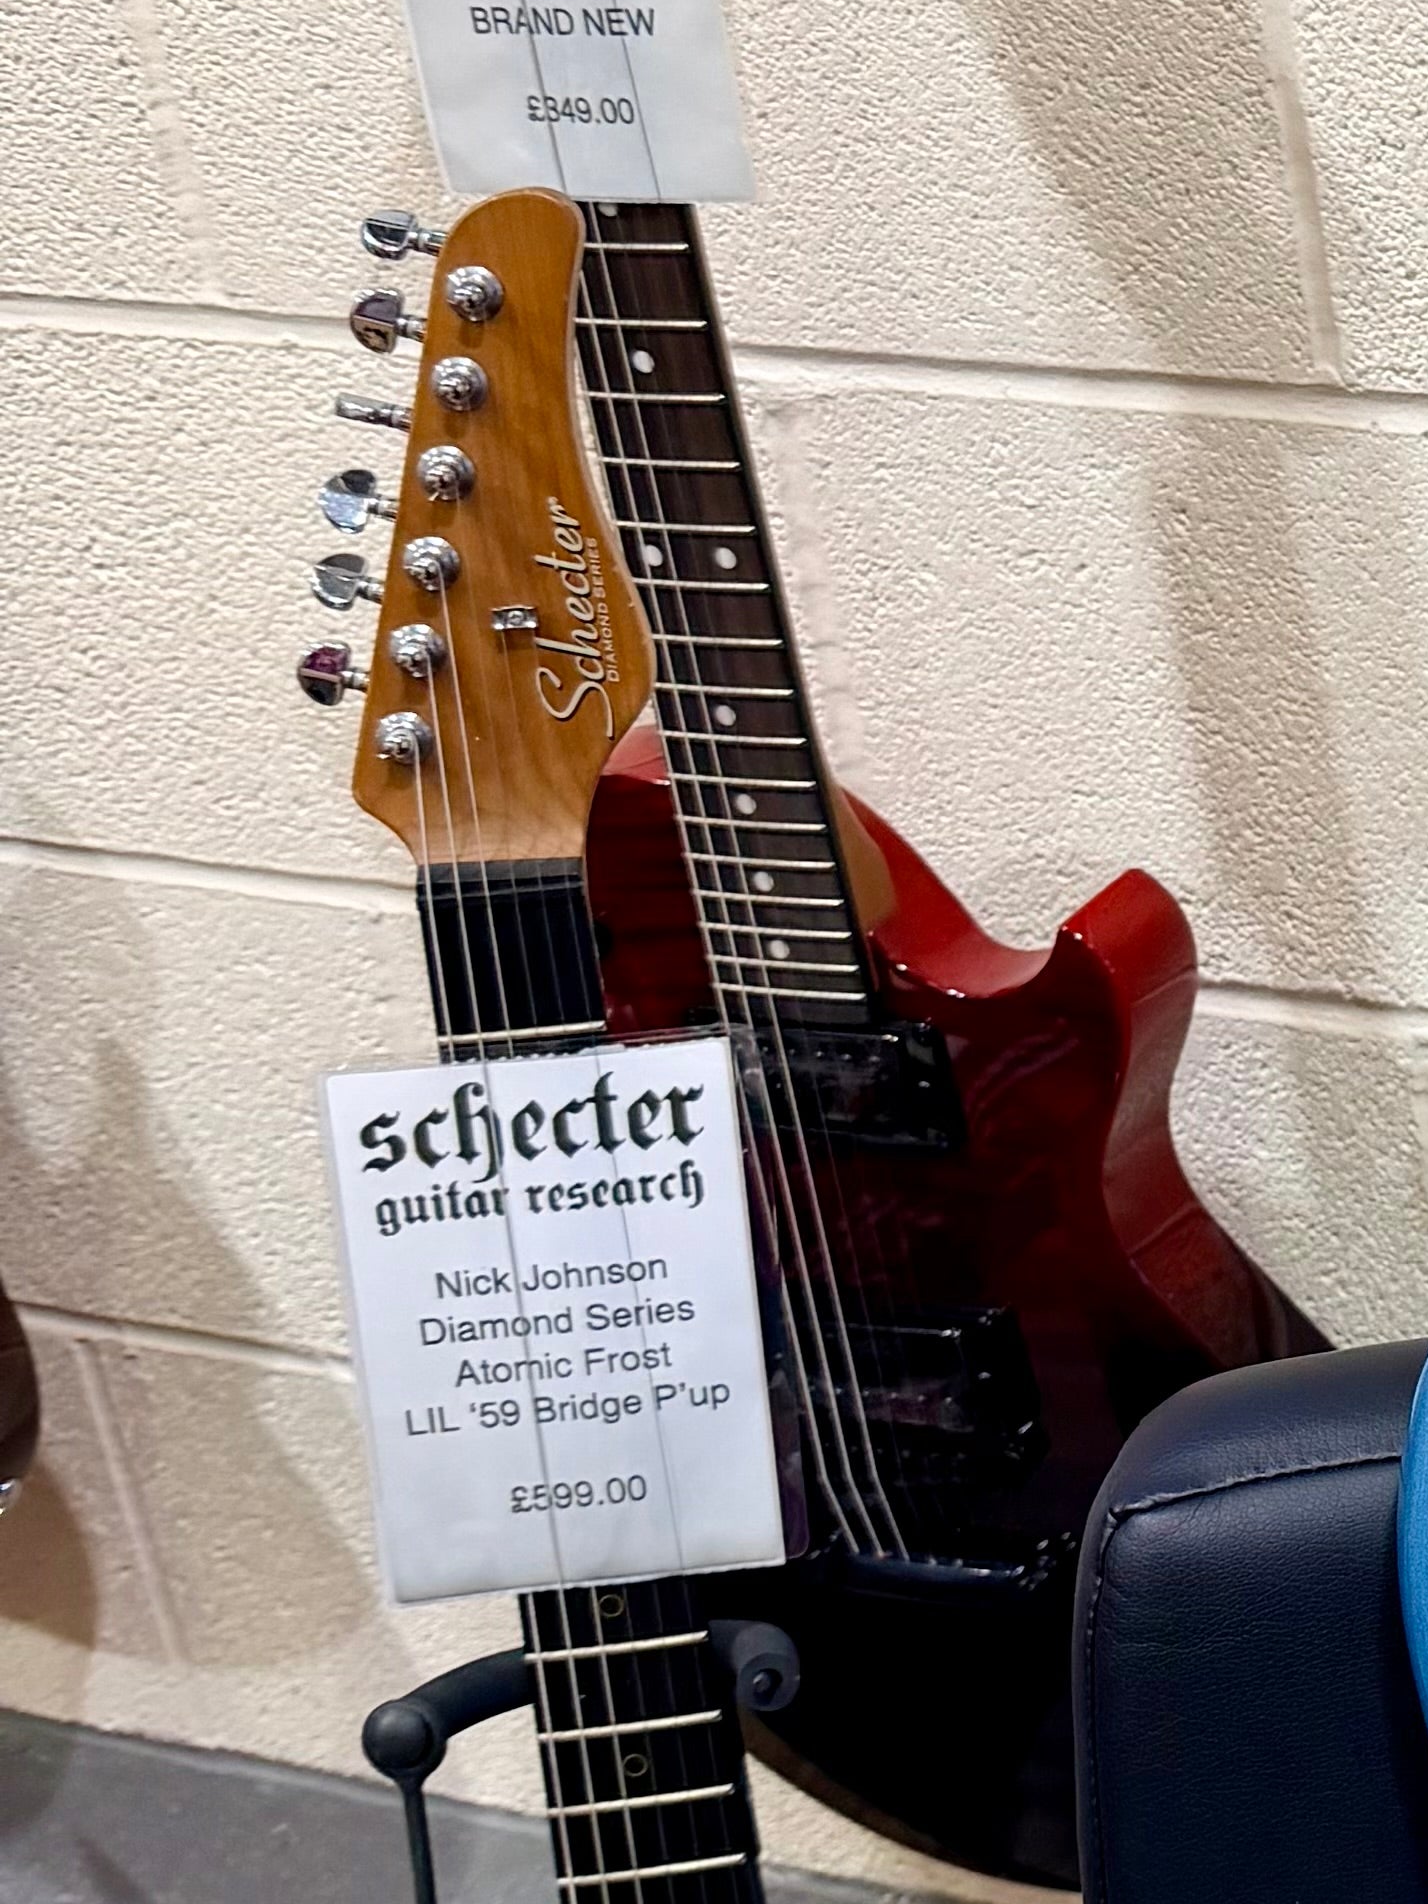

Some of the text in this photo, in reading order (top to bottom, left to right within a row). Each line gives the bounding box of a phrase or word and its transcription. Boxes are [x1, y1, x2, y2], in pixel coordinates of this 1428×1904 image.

[469, 7, 655, 37] BRAND NEW
[534, 496, 614, 738] Schecter
[586, 537, 620, 683] DIAMOND SERIES
[360, 1071, 705, 1183] schecter
[375, 1160, 706, 1236] guitar research
[435, 1256, 668, 1299] Nick Johnson
[420, 1296, 696, 1346] Diamond Series
[455, 1341, 673, 1387] Atomic Frost
[405, 1380, 731, 1436] LIL '59 Bridge P'up
[510, 1474, 647, 1513] £599.00
